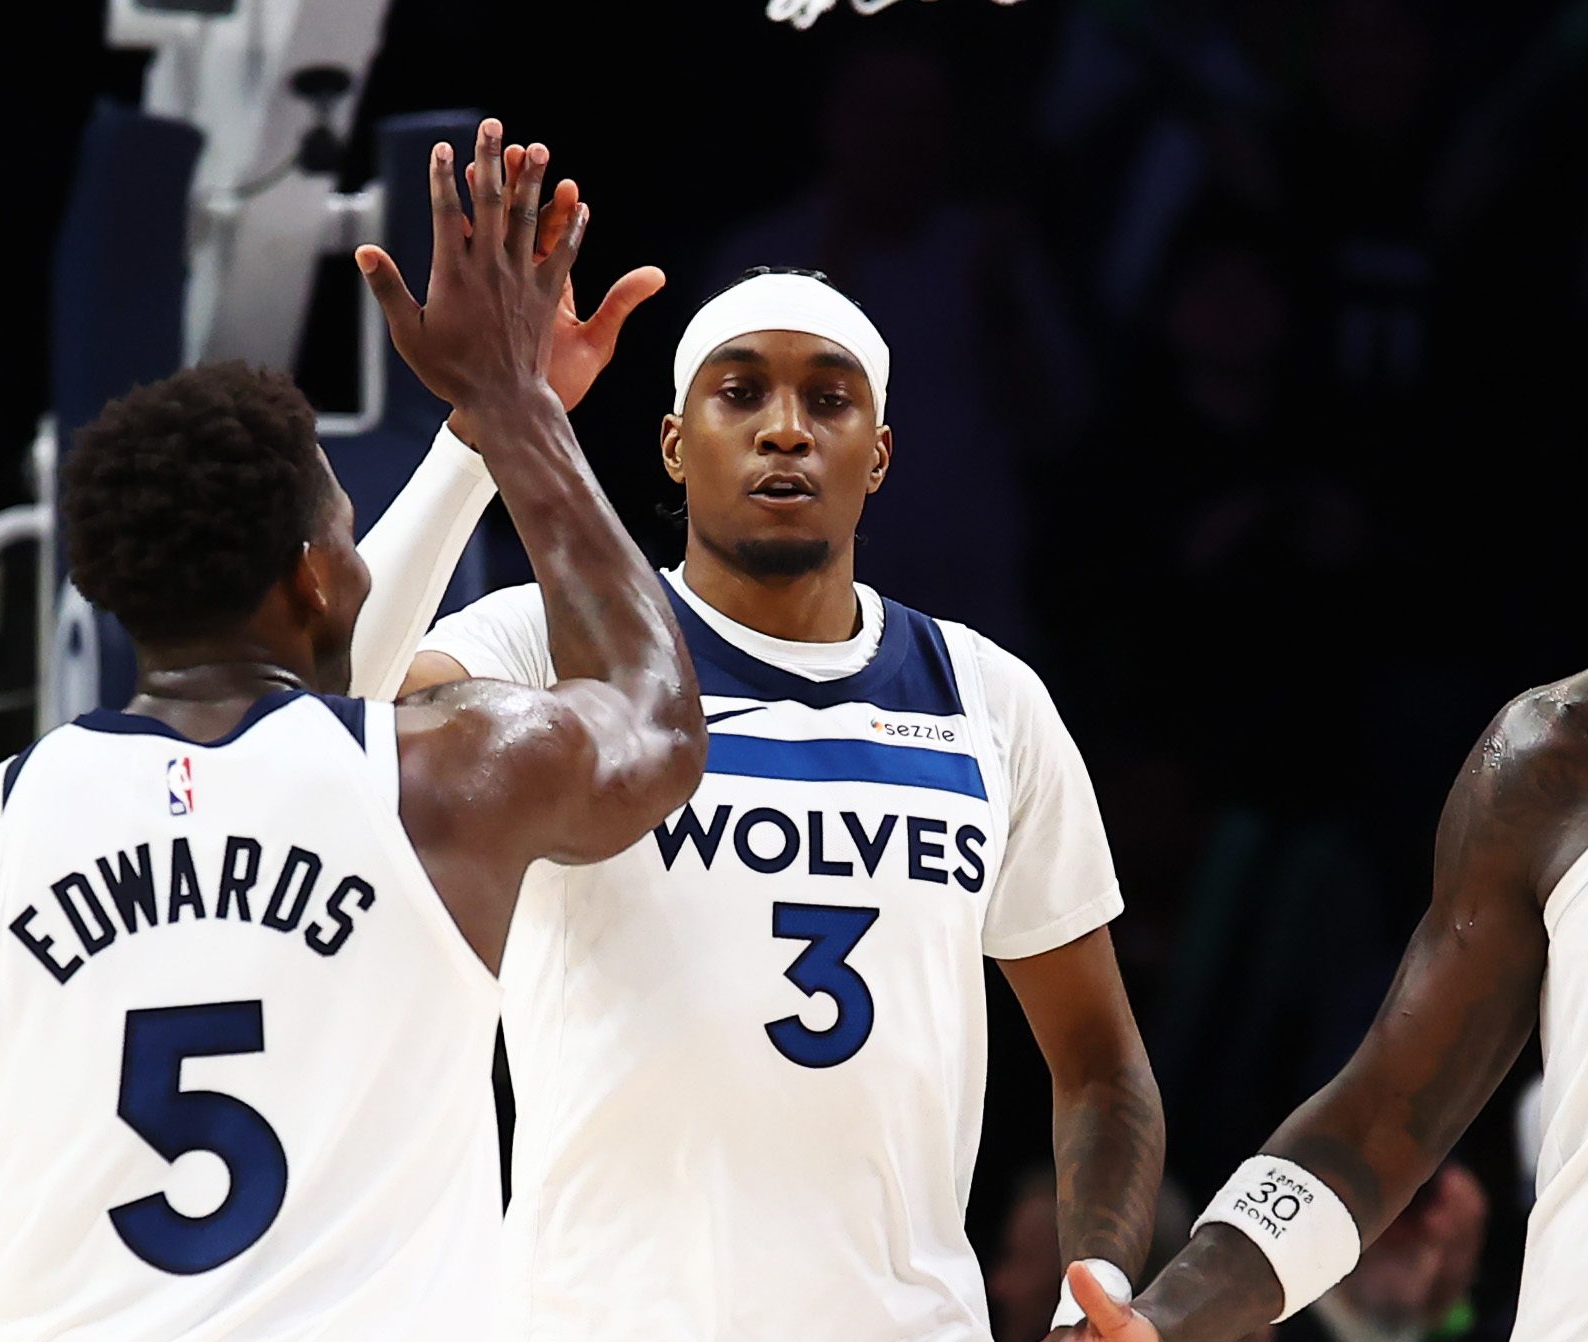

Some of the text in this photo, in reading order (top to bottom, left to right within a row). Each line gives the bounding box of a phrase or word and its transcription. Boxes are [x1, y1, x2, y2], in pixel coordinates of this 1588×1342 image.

[884, 723, 956, 743] sezzle
[653, 801, 987, 894] WOLVES
[8, 835, 377, 985] EDWARDS
[763, 901, 881, 1069] 3
[107, 999, 289, 1276] 5
[1245, 1181, 1301, 1222] 30
